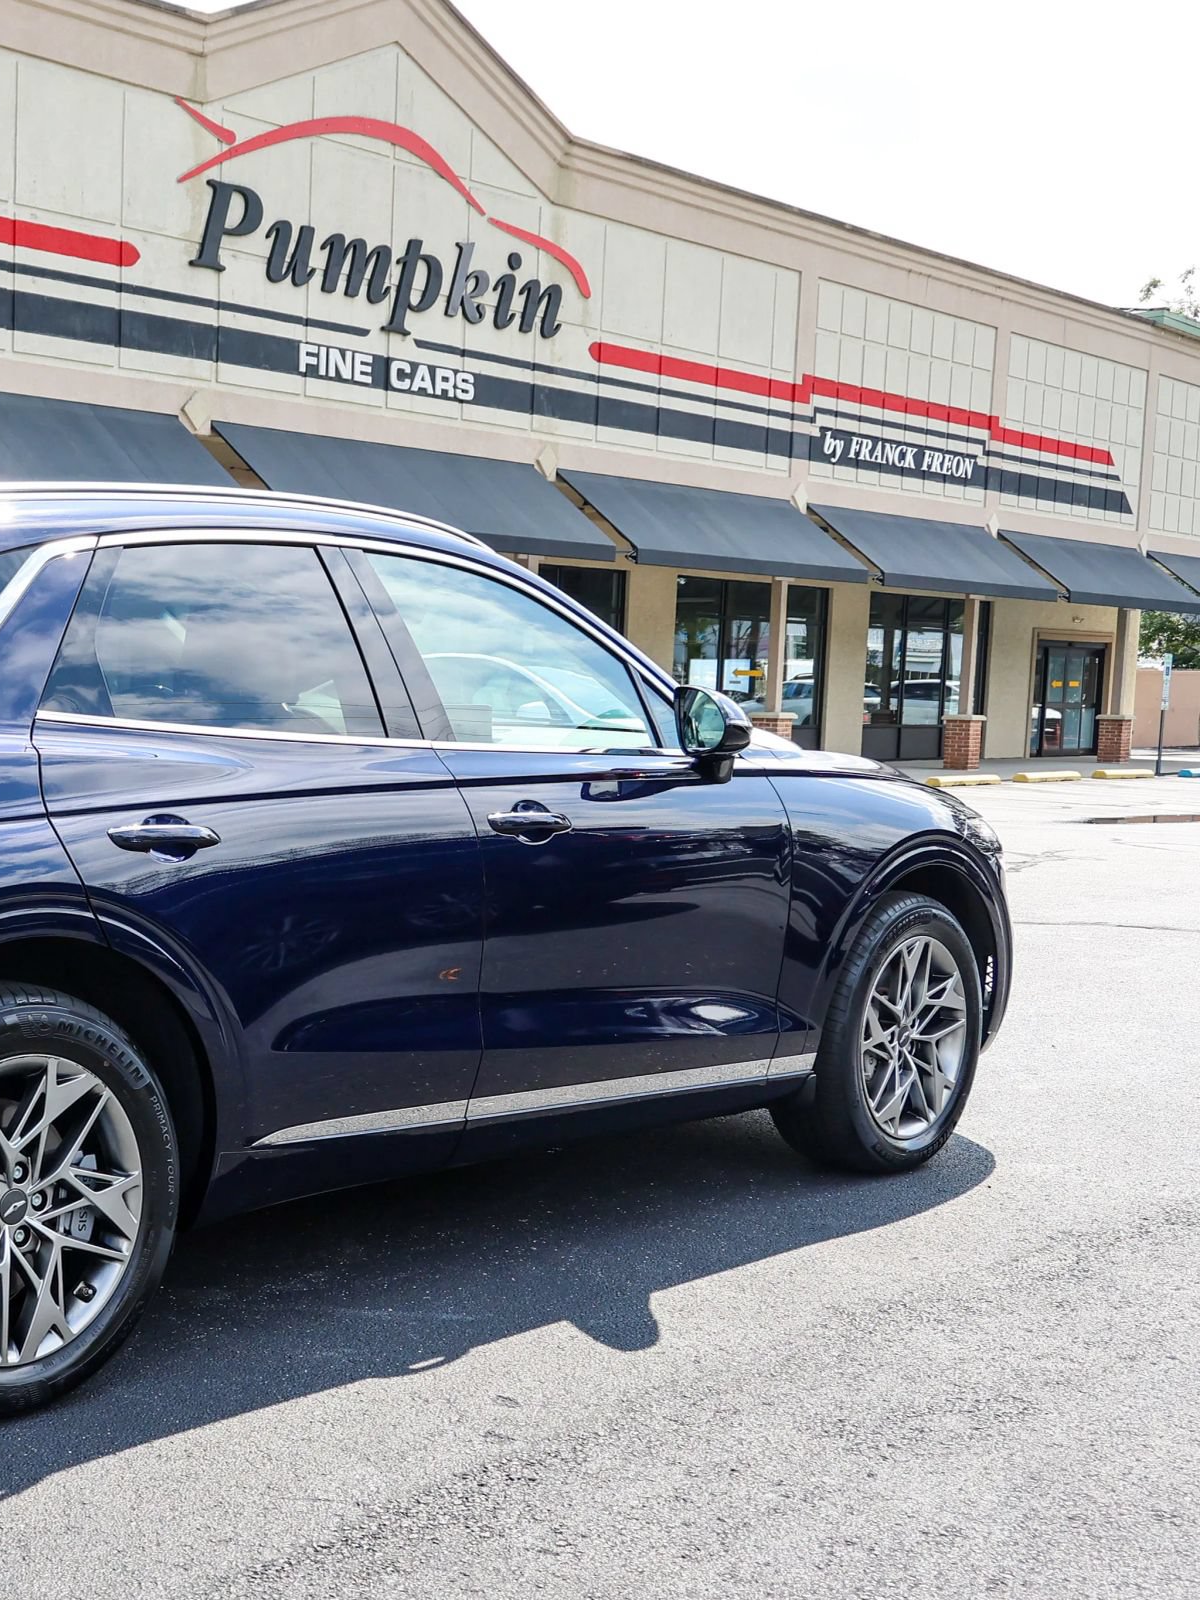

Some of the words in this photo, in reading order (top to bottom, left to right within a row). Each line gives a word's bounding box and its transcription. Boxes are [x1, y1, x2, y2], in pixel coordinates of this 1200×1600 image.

[188, 179, 563, 339] Pumpkin
[299, 342, 373, 384] FINE
[389, 360, 476, 401] CARS
[823, 431, 844, 463] by
[848, 436, 917, 470] FRANCK
[920, 449, 976, 480] FREON
[56, 1018, 146, 1083] MICHELIN
